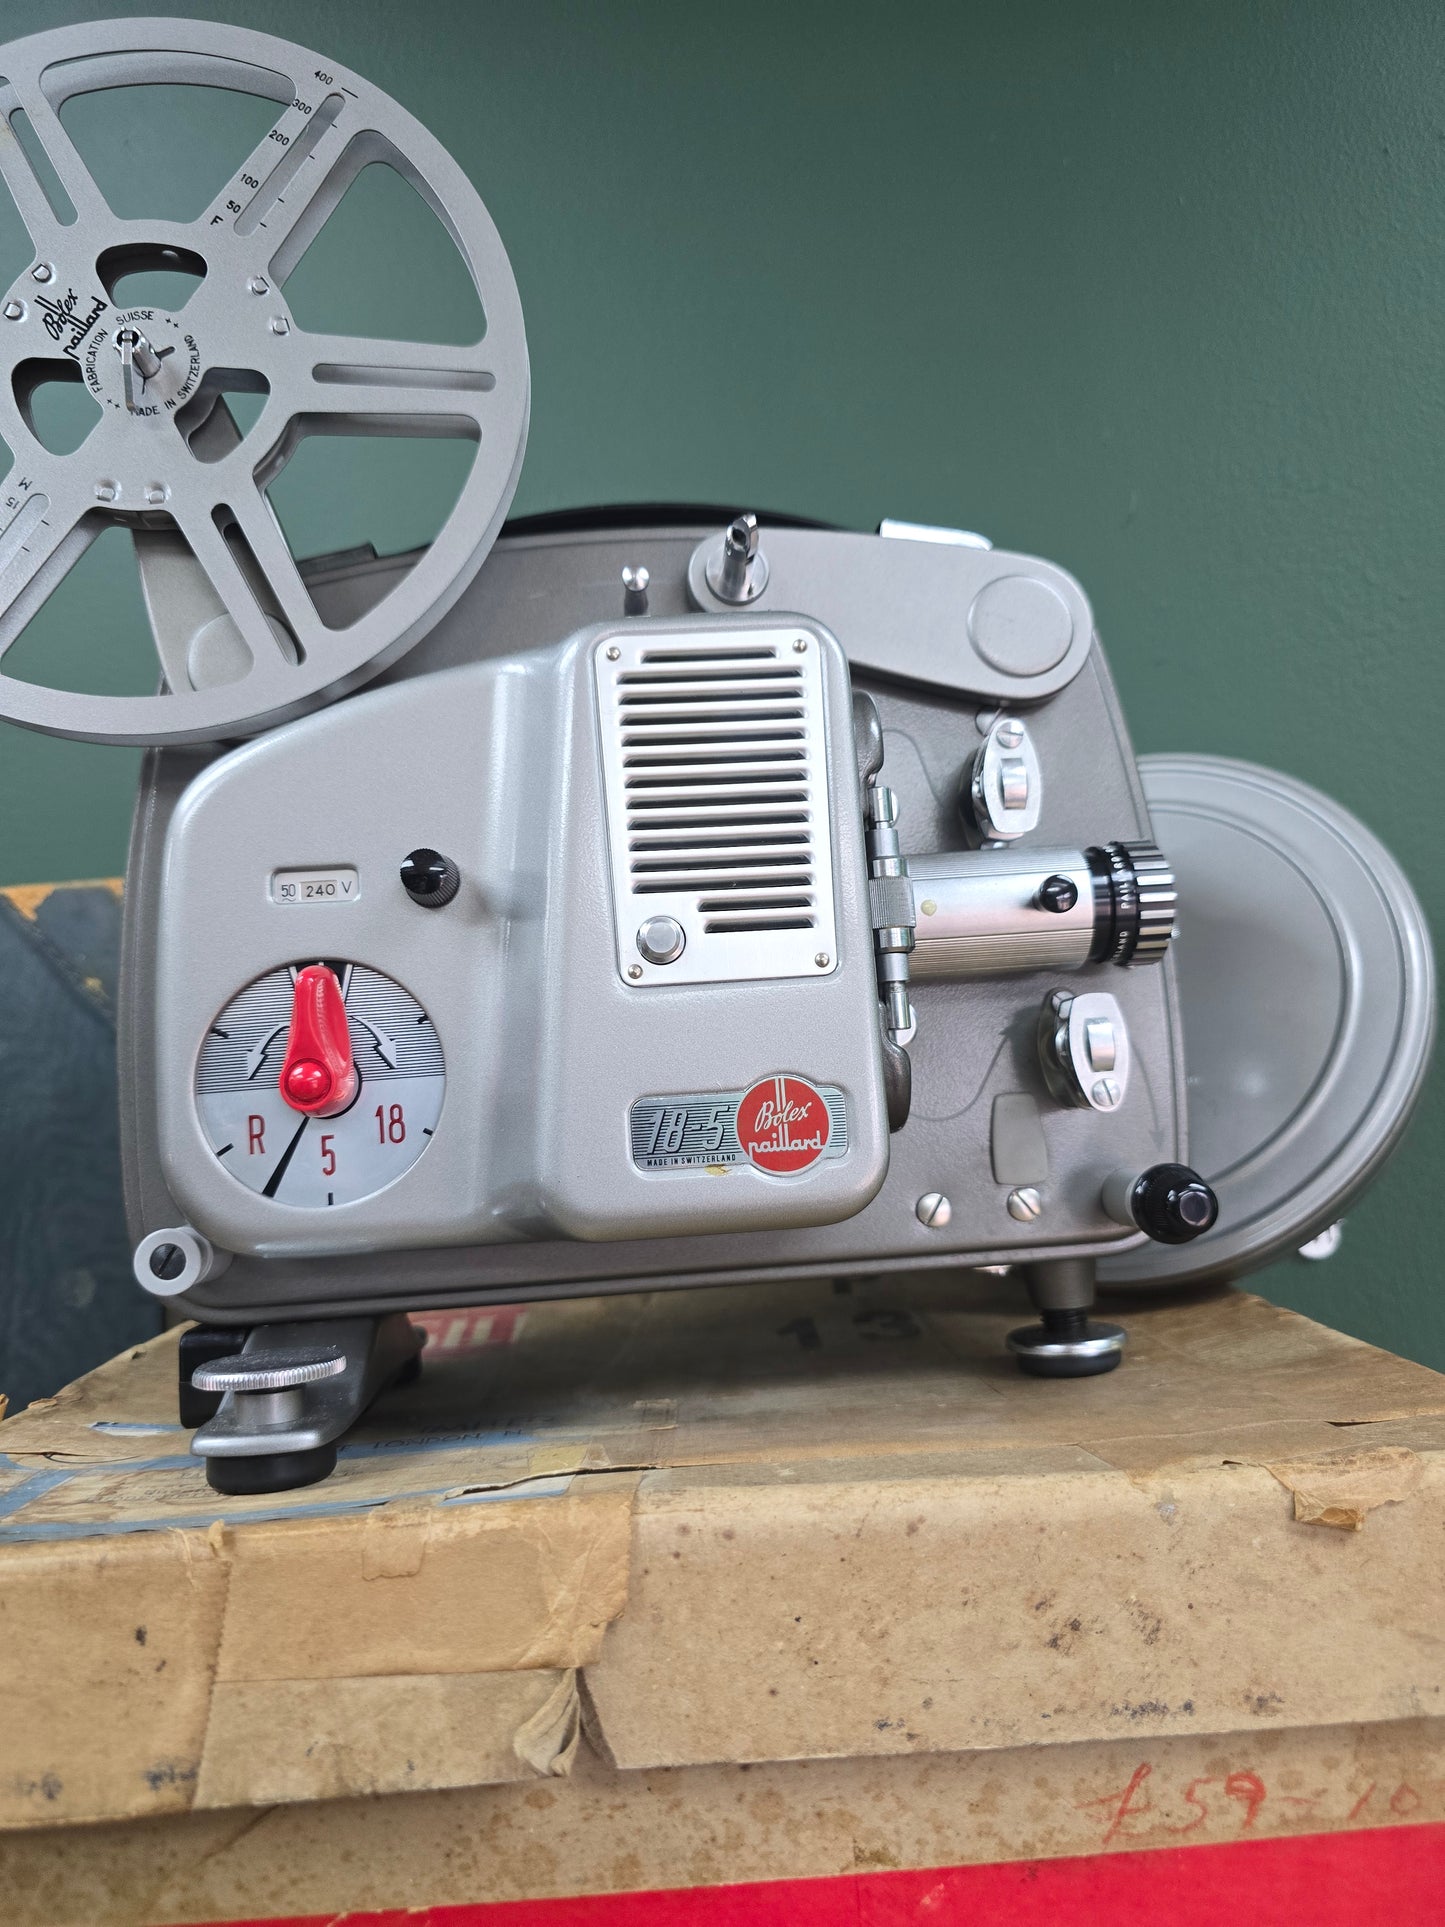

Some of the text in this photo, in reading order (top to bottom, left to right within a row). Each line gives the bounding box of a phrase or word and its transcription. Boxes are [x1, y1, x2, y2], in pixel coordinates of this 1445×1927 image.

[313, 69, 334, 85] 400
[291, 98, 312, 115] 300
[269, 130, 290, 146] 200
[240, 173, 259, 189] 100
[226, 200, 242, 214] 50
[210, 215, 224, 227] F
[35, 288, 78, 340] Bolex
[85, 311, 155, 393] FABRICATION SUISSE
[164, 397, 178, 411] IN
[177, 334, 201, 400] SWITZERLAND
[306, 883, 336, 898] 240
[341, 880, 353, 894] V
[374, 1103, 407, 1145] 18
[754, 1097, 813, 1133] Bolex
[248, 1114, 266, 1155] R
[646, 1105, 730, 1155] 18-5
[320, 1134, 337, 1176] 5
[647, 1154, 736, 1167] MADE IN SWITZERLAND
